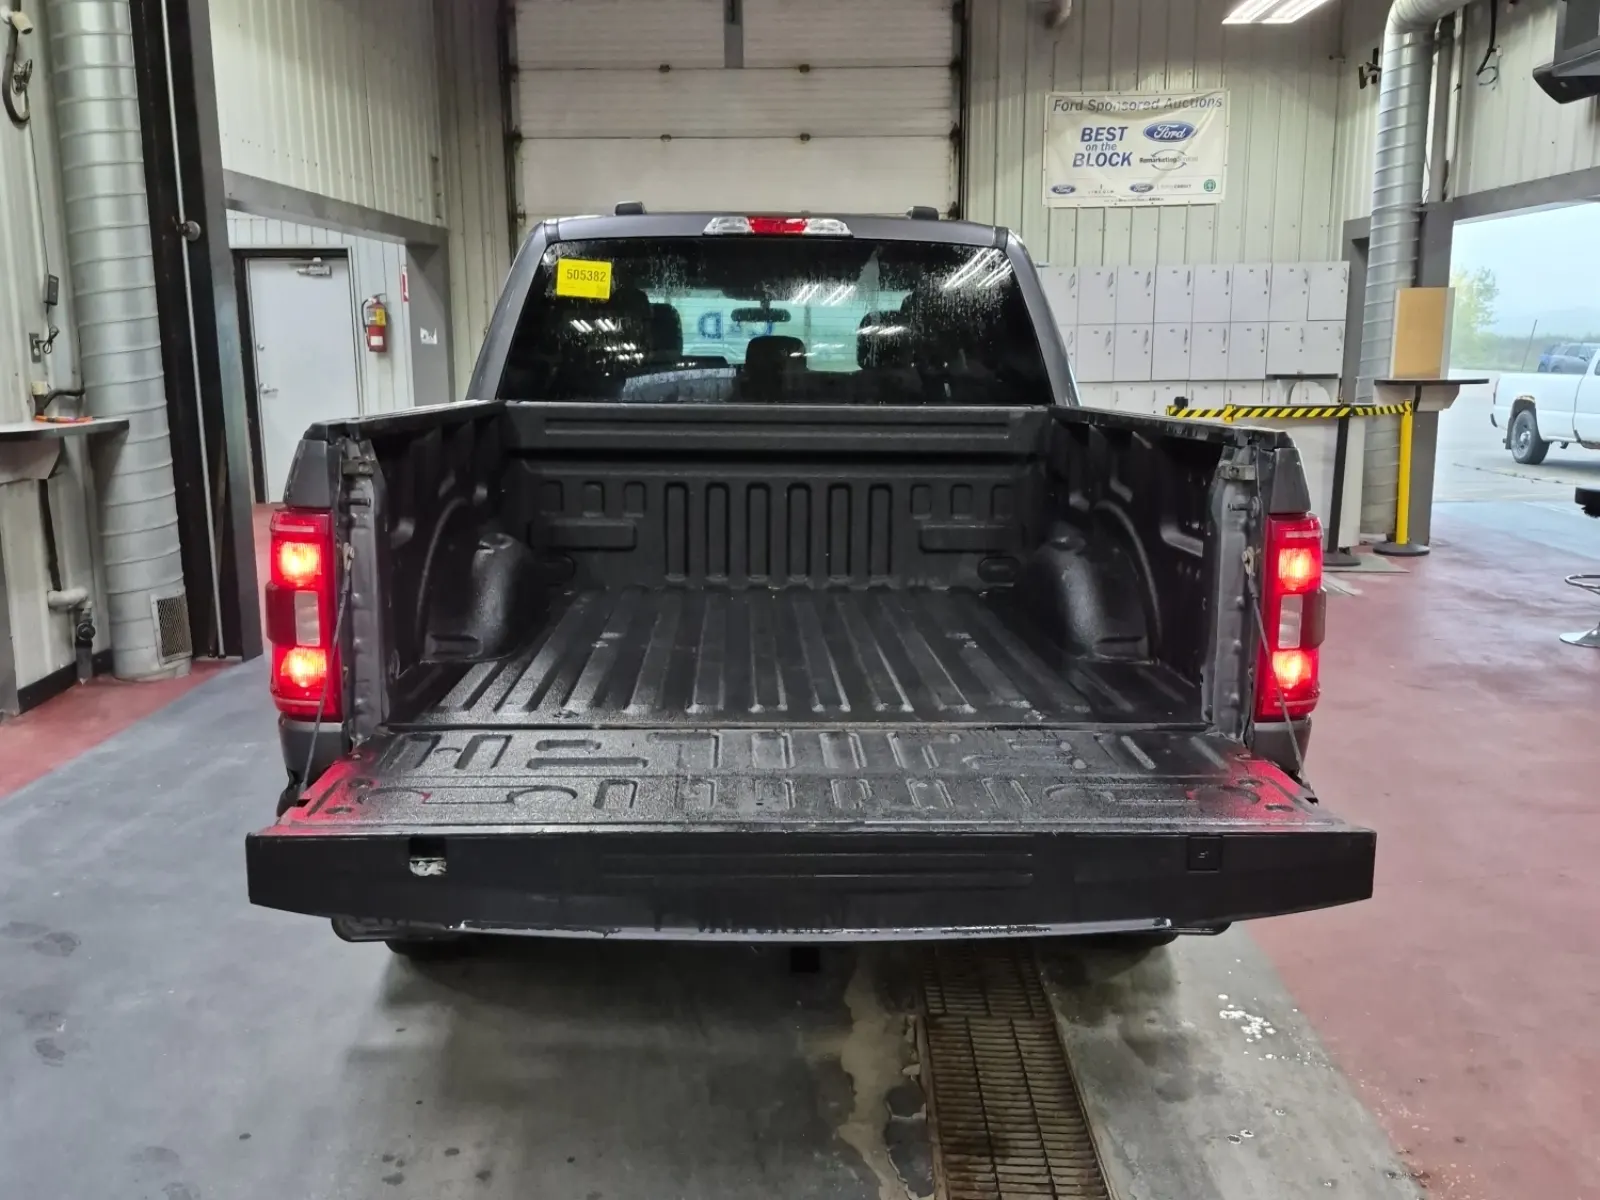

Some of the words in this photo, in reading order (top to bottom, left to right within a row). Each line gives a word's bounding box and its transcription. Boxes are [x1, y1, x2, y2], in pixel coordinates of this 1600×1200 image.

[1053, 99, 1083, 112] Ford
[1087, 98, 1160, 112] Sponsored
[1163, 95, 1223, 110] Auctions
[1080, 126, 1129, 142] BEST
[1153, 124, 1187, 139] Ford
[1085, 143, 1098, 151] on
[1100, 142, 1117, 151] the
[1072, 152, 1133, 168] BLOCK
[566, 268, 607, 283] 505382
